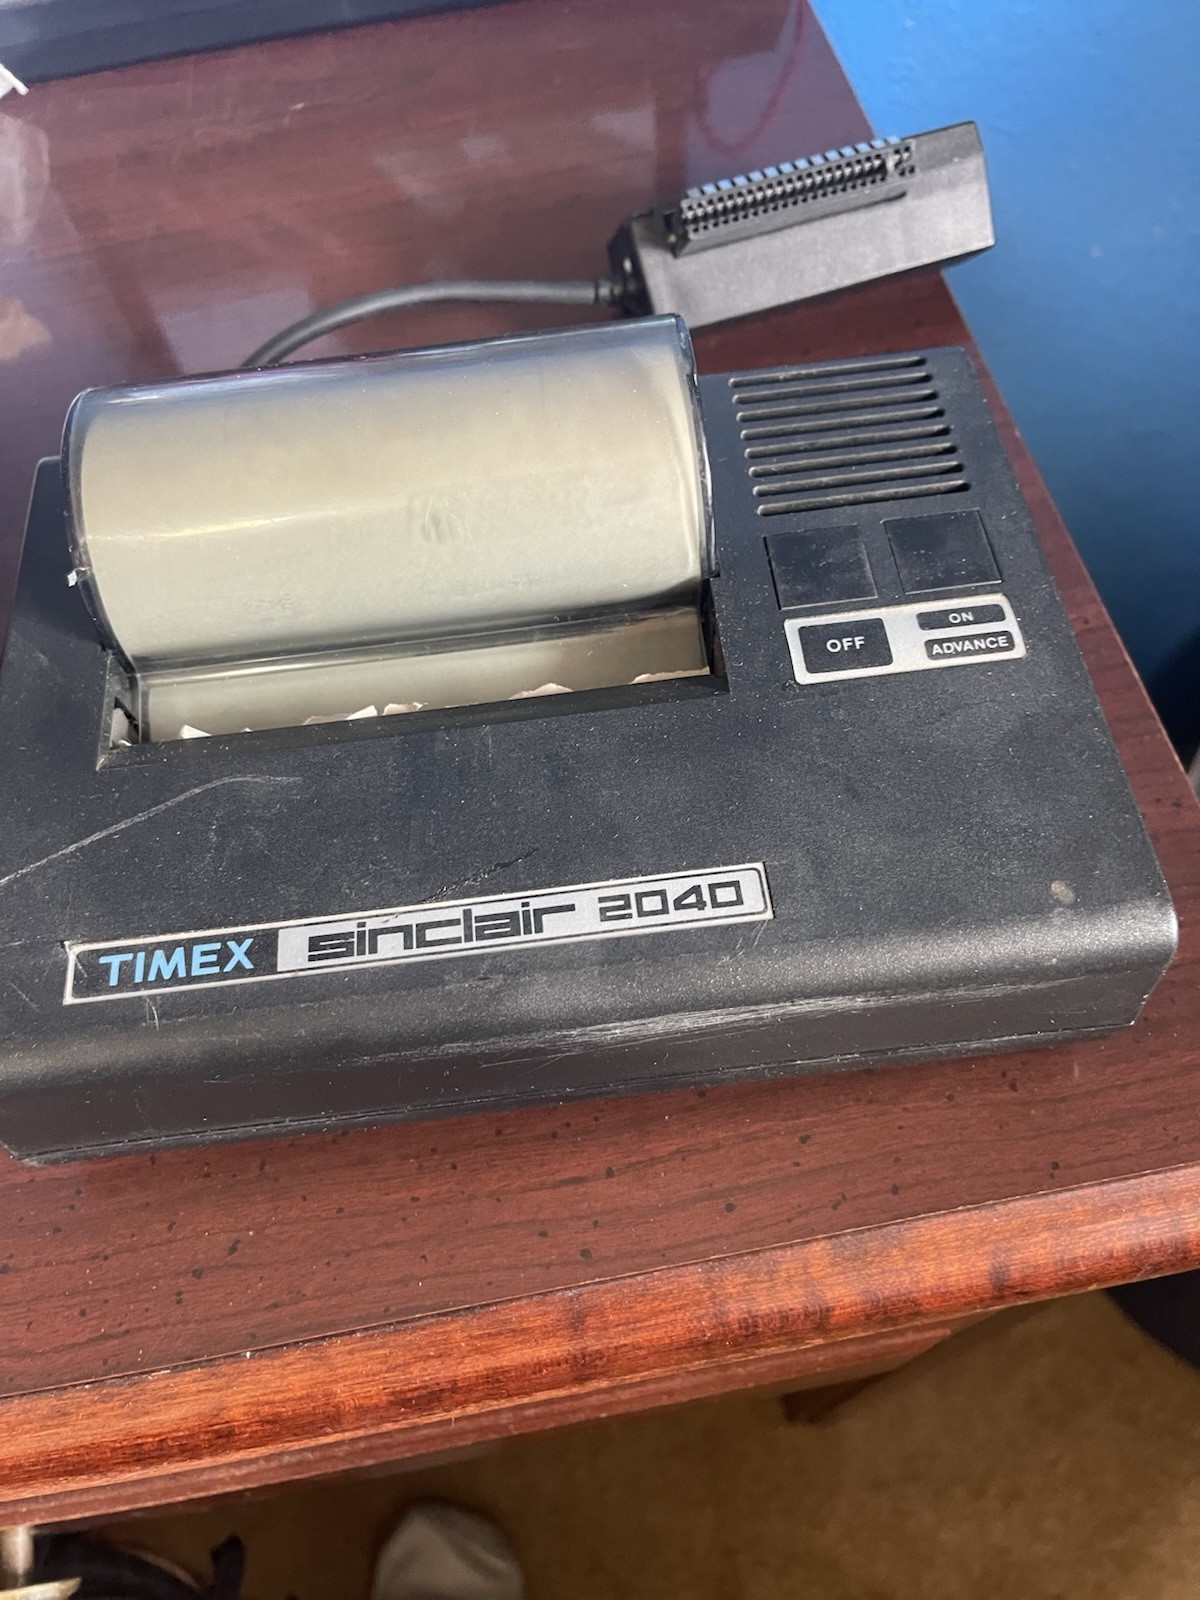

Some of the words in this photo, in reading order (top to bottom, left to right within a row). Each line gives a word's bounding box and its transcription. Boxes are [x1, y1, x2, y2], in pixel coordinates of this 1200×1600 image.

[948, 611, 974, 624] ON
[826, 636, 865, 653] OFF
[931, 636, 1009, 655] ADVANCE
[99, 938, 254, 986] TIMEX
[308, 901, 575, 962] sinclair
[598, 880, 744, 922] 2040
